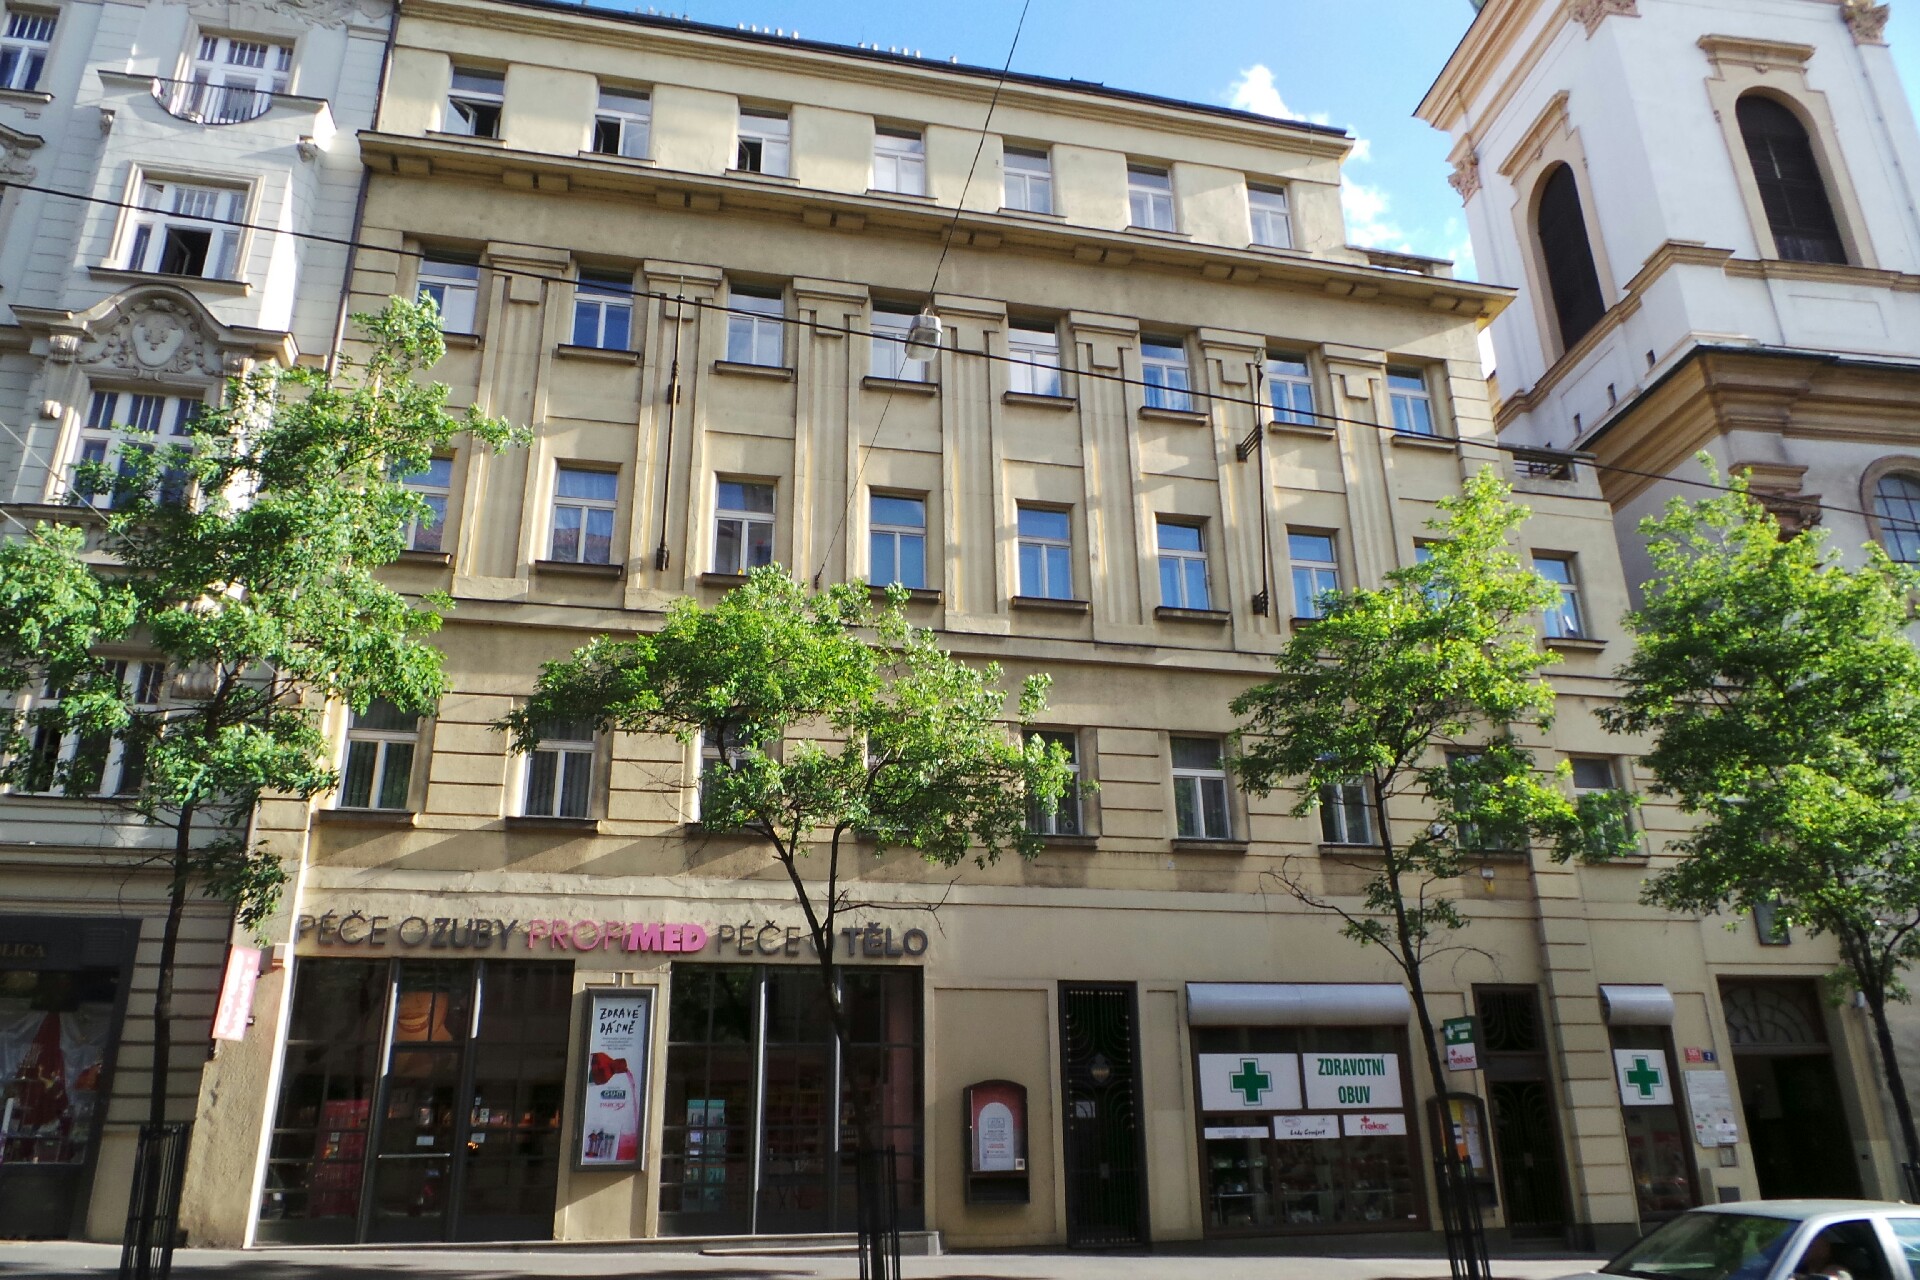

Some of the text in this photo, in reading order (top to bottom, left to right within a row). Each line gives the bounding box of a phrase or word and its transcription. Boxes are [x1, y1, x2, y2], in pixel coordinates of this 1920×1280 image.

[294, 909, 389, 946] PÉČE
[528, 919, 708, 952] PROFIMED
[717, 920, 801, 956] PÉČE
[600, 1004, 642, 1020] ZDRAVÉ
[600, 1020, 636, 1036] DÁSNĚ
[1317, 1054, 1386, 1076] ZDRAVOTNÍ
[1338, 1086, 1370, 1104] OBUV
